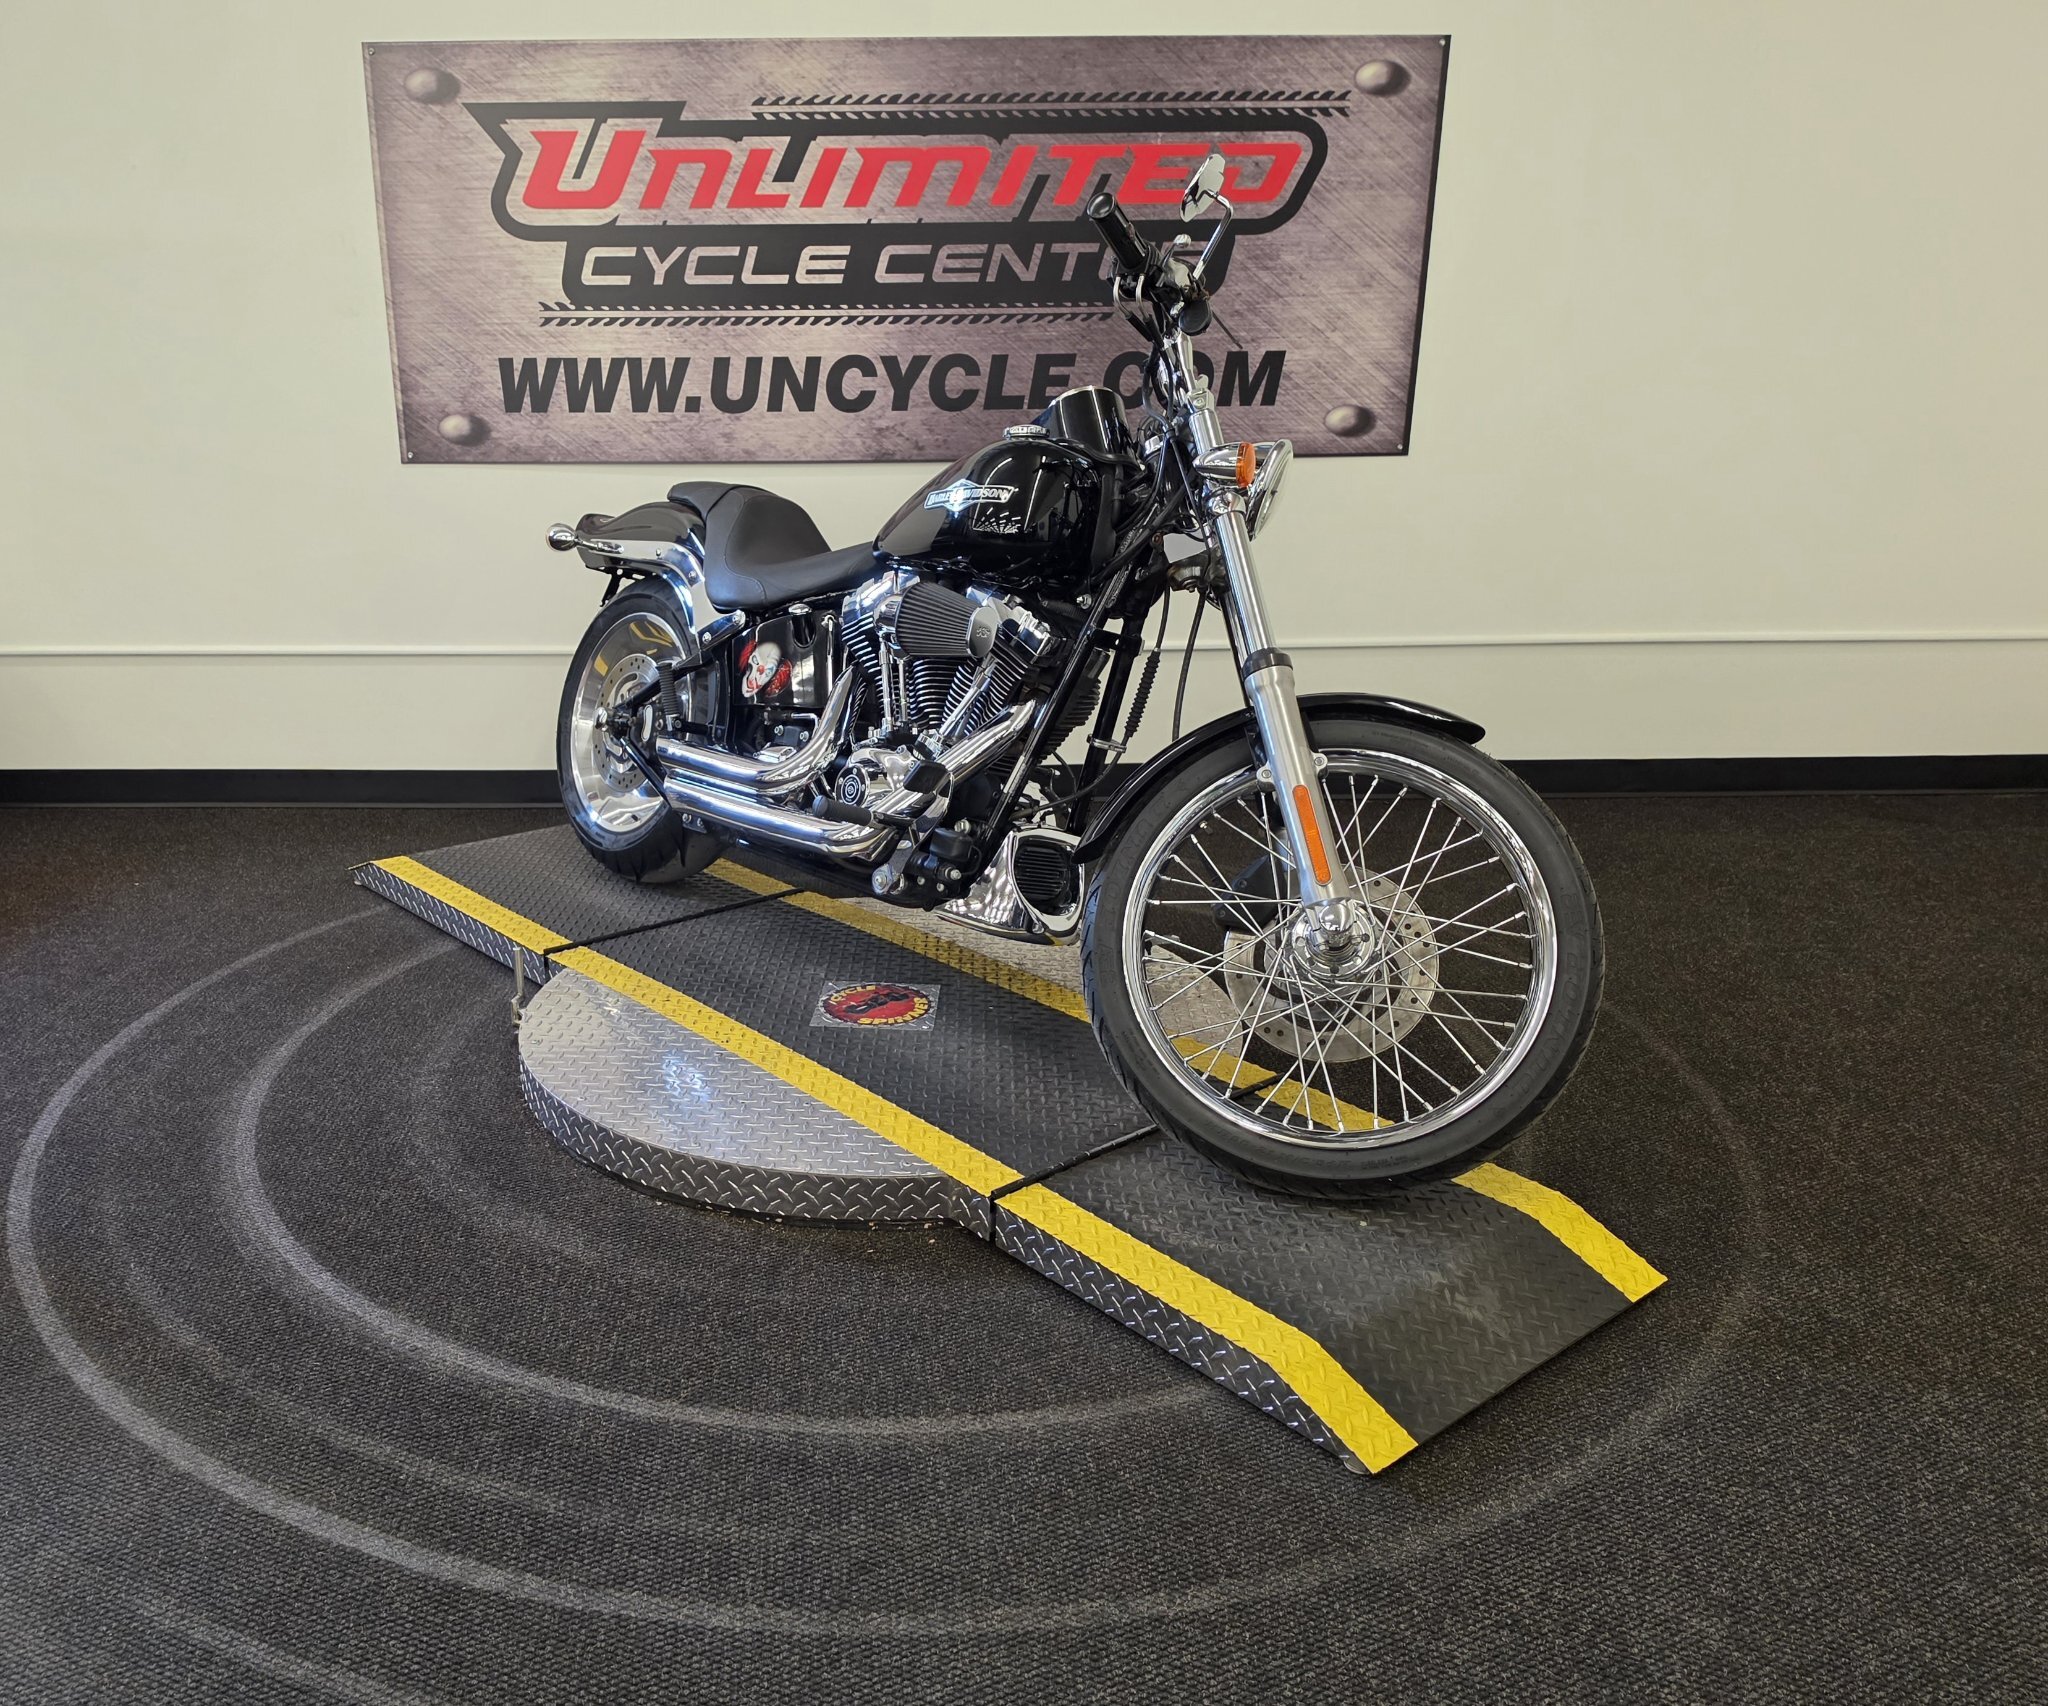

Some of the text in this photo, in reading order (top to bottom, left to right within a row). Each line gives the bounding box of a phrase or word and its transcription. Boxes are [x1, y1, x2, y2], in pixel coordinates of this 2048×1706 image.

[581, 240, 1210, 285] CYCLE CENT
[498, 350, 1287, 413] WWW.UNCYCLECM
[830, 985, 876, 1002] CYCLE
[857, 997, 929, 1024] SPINNER
